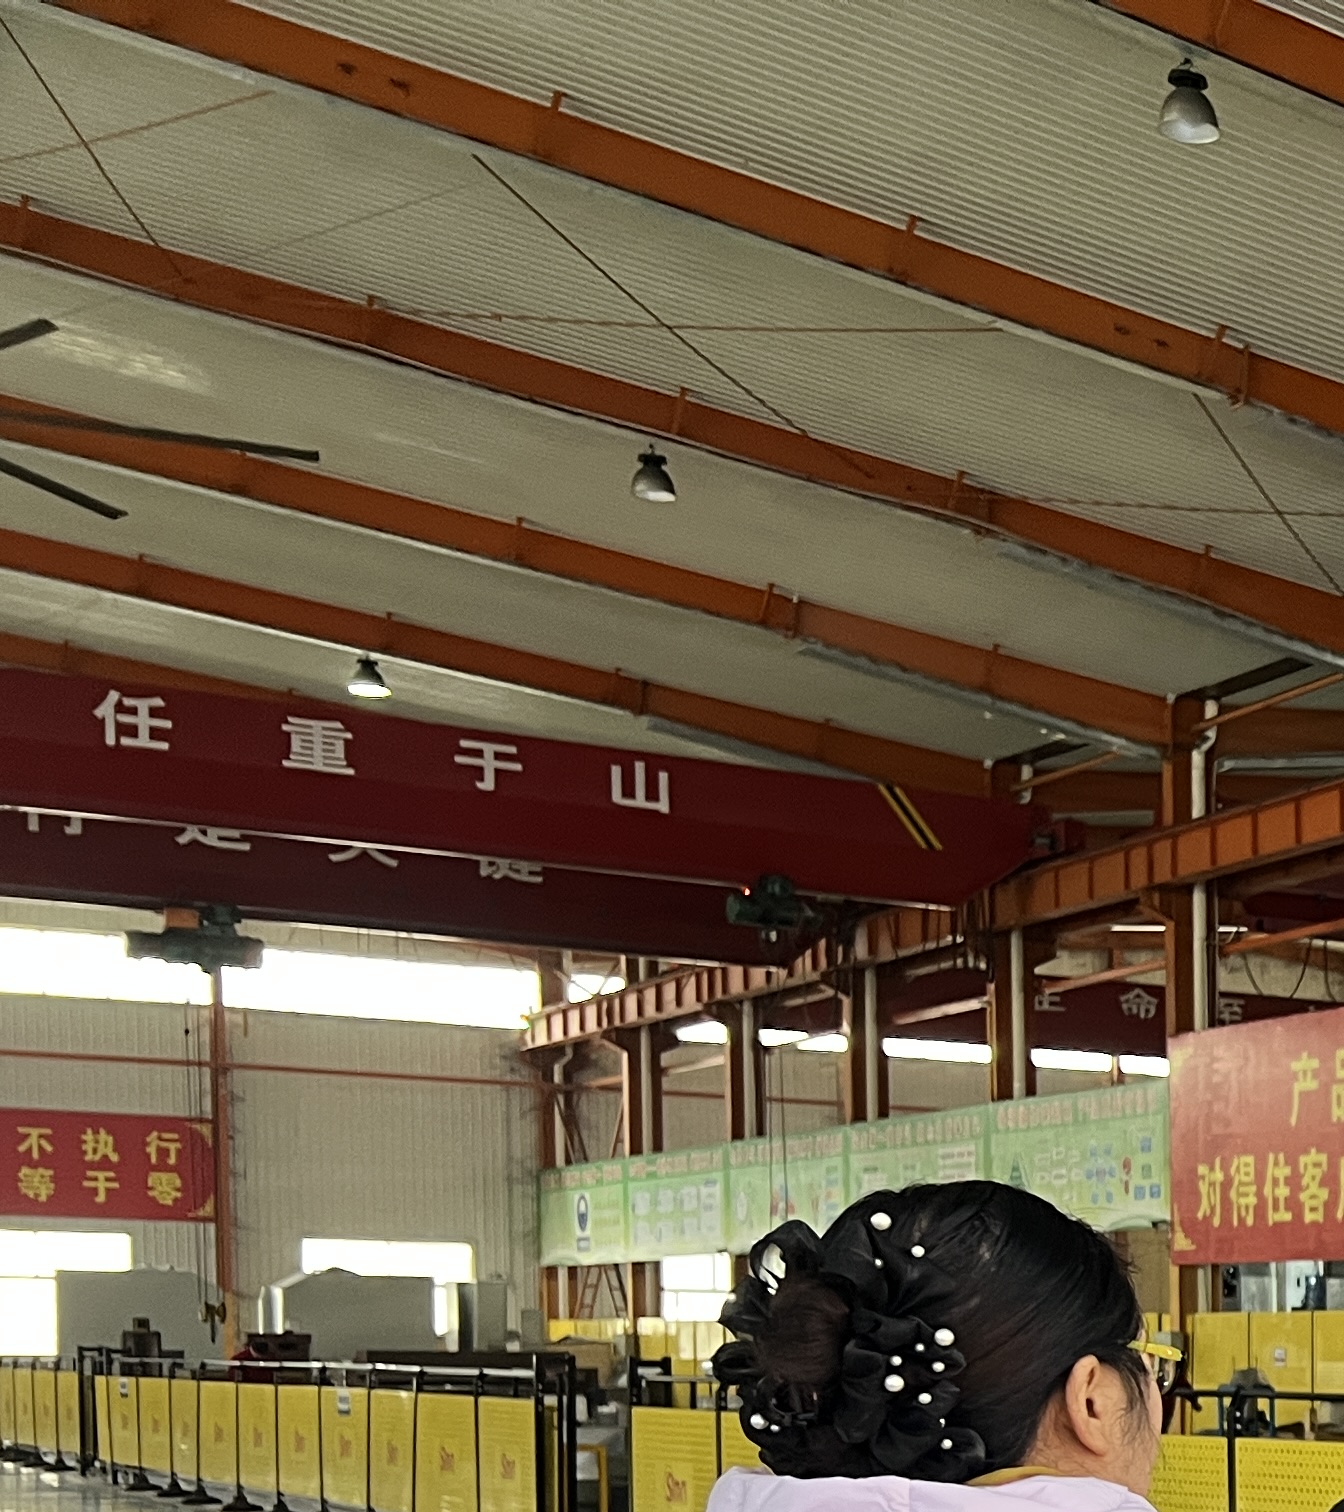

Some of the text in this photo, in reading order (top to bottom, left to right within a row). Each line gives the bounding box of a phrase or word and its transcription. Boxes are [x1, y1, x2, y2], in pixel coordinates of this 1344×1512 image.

[93, 689, 670, 815] 任重于山
[16, 1126, 183, 1165] 不执行
[17, 1166, 183, 1207] 等于零
